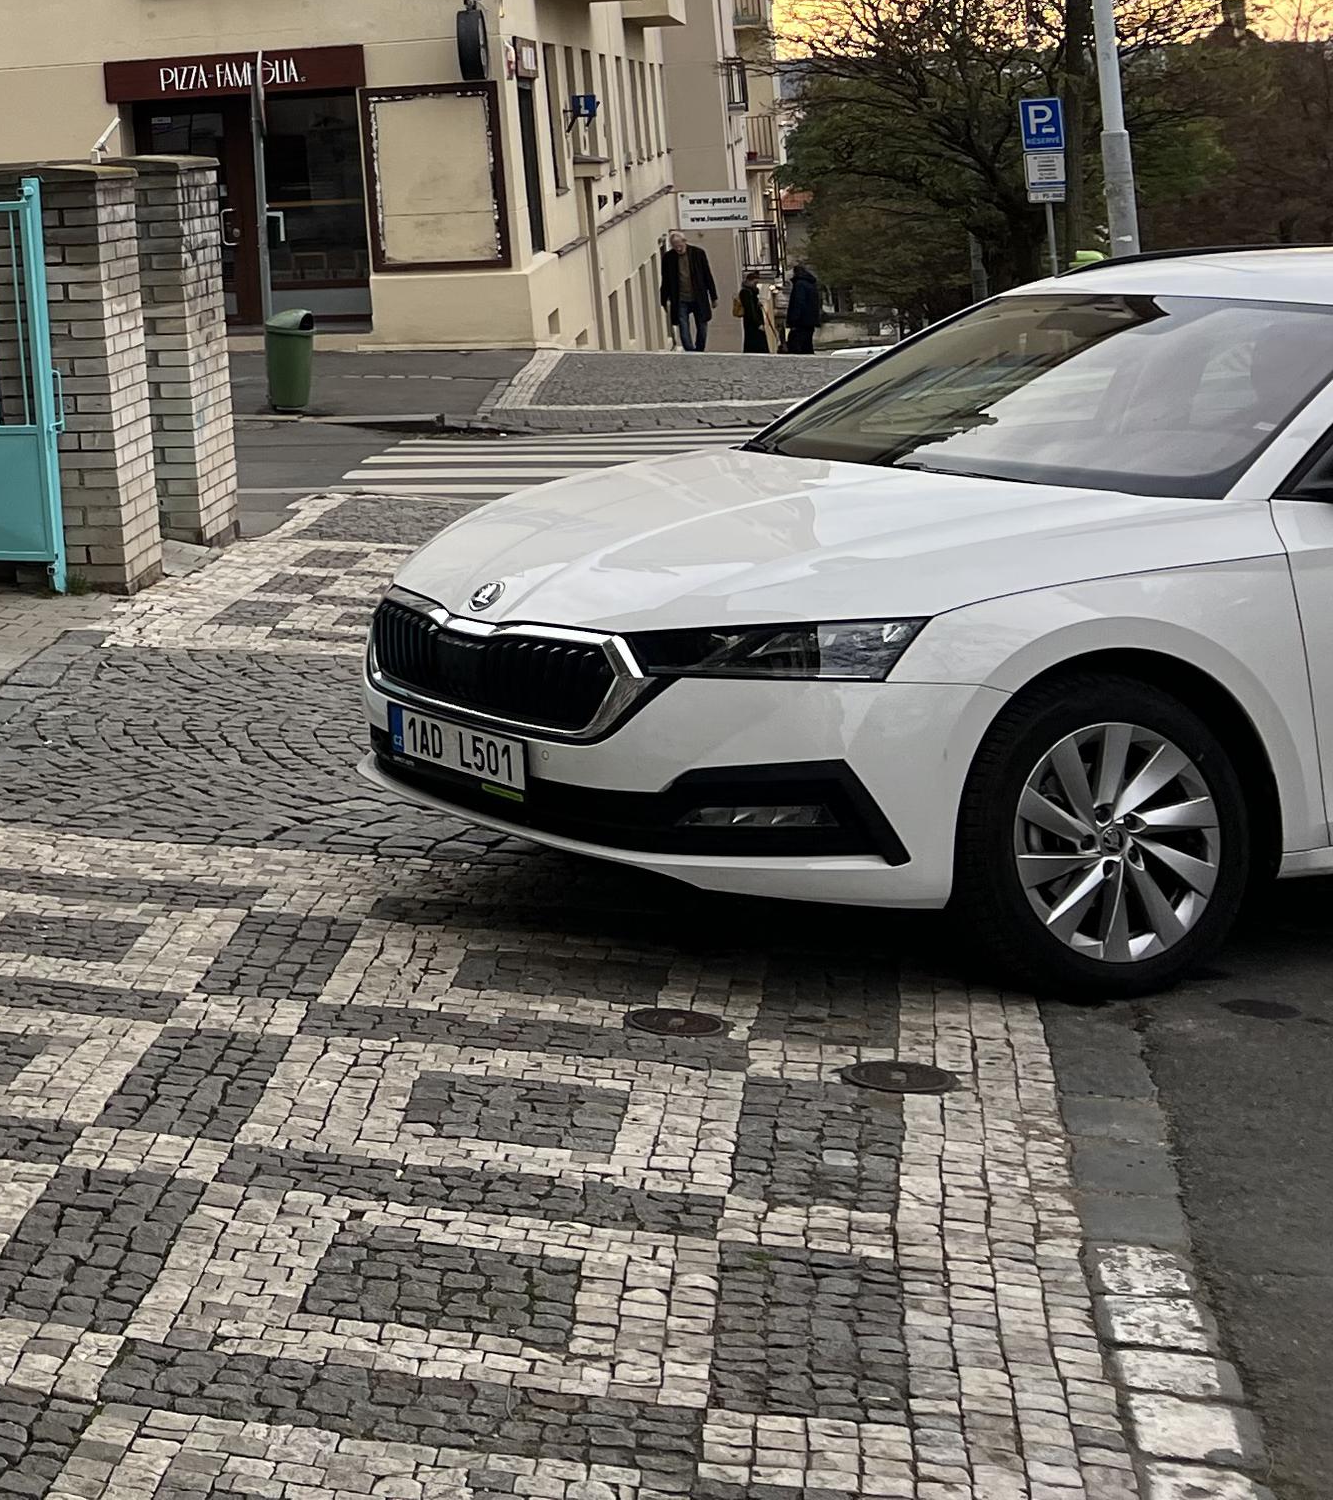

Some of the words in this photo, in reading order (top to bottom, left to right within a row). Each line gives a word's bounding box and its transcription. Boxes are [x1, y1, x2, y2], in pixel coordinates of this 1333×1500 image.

[1028, 105, 1052, 134] P
[408, 716, 443, 759] 1AD
[458, 731, 513, 782] L501
